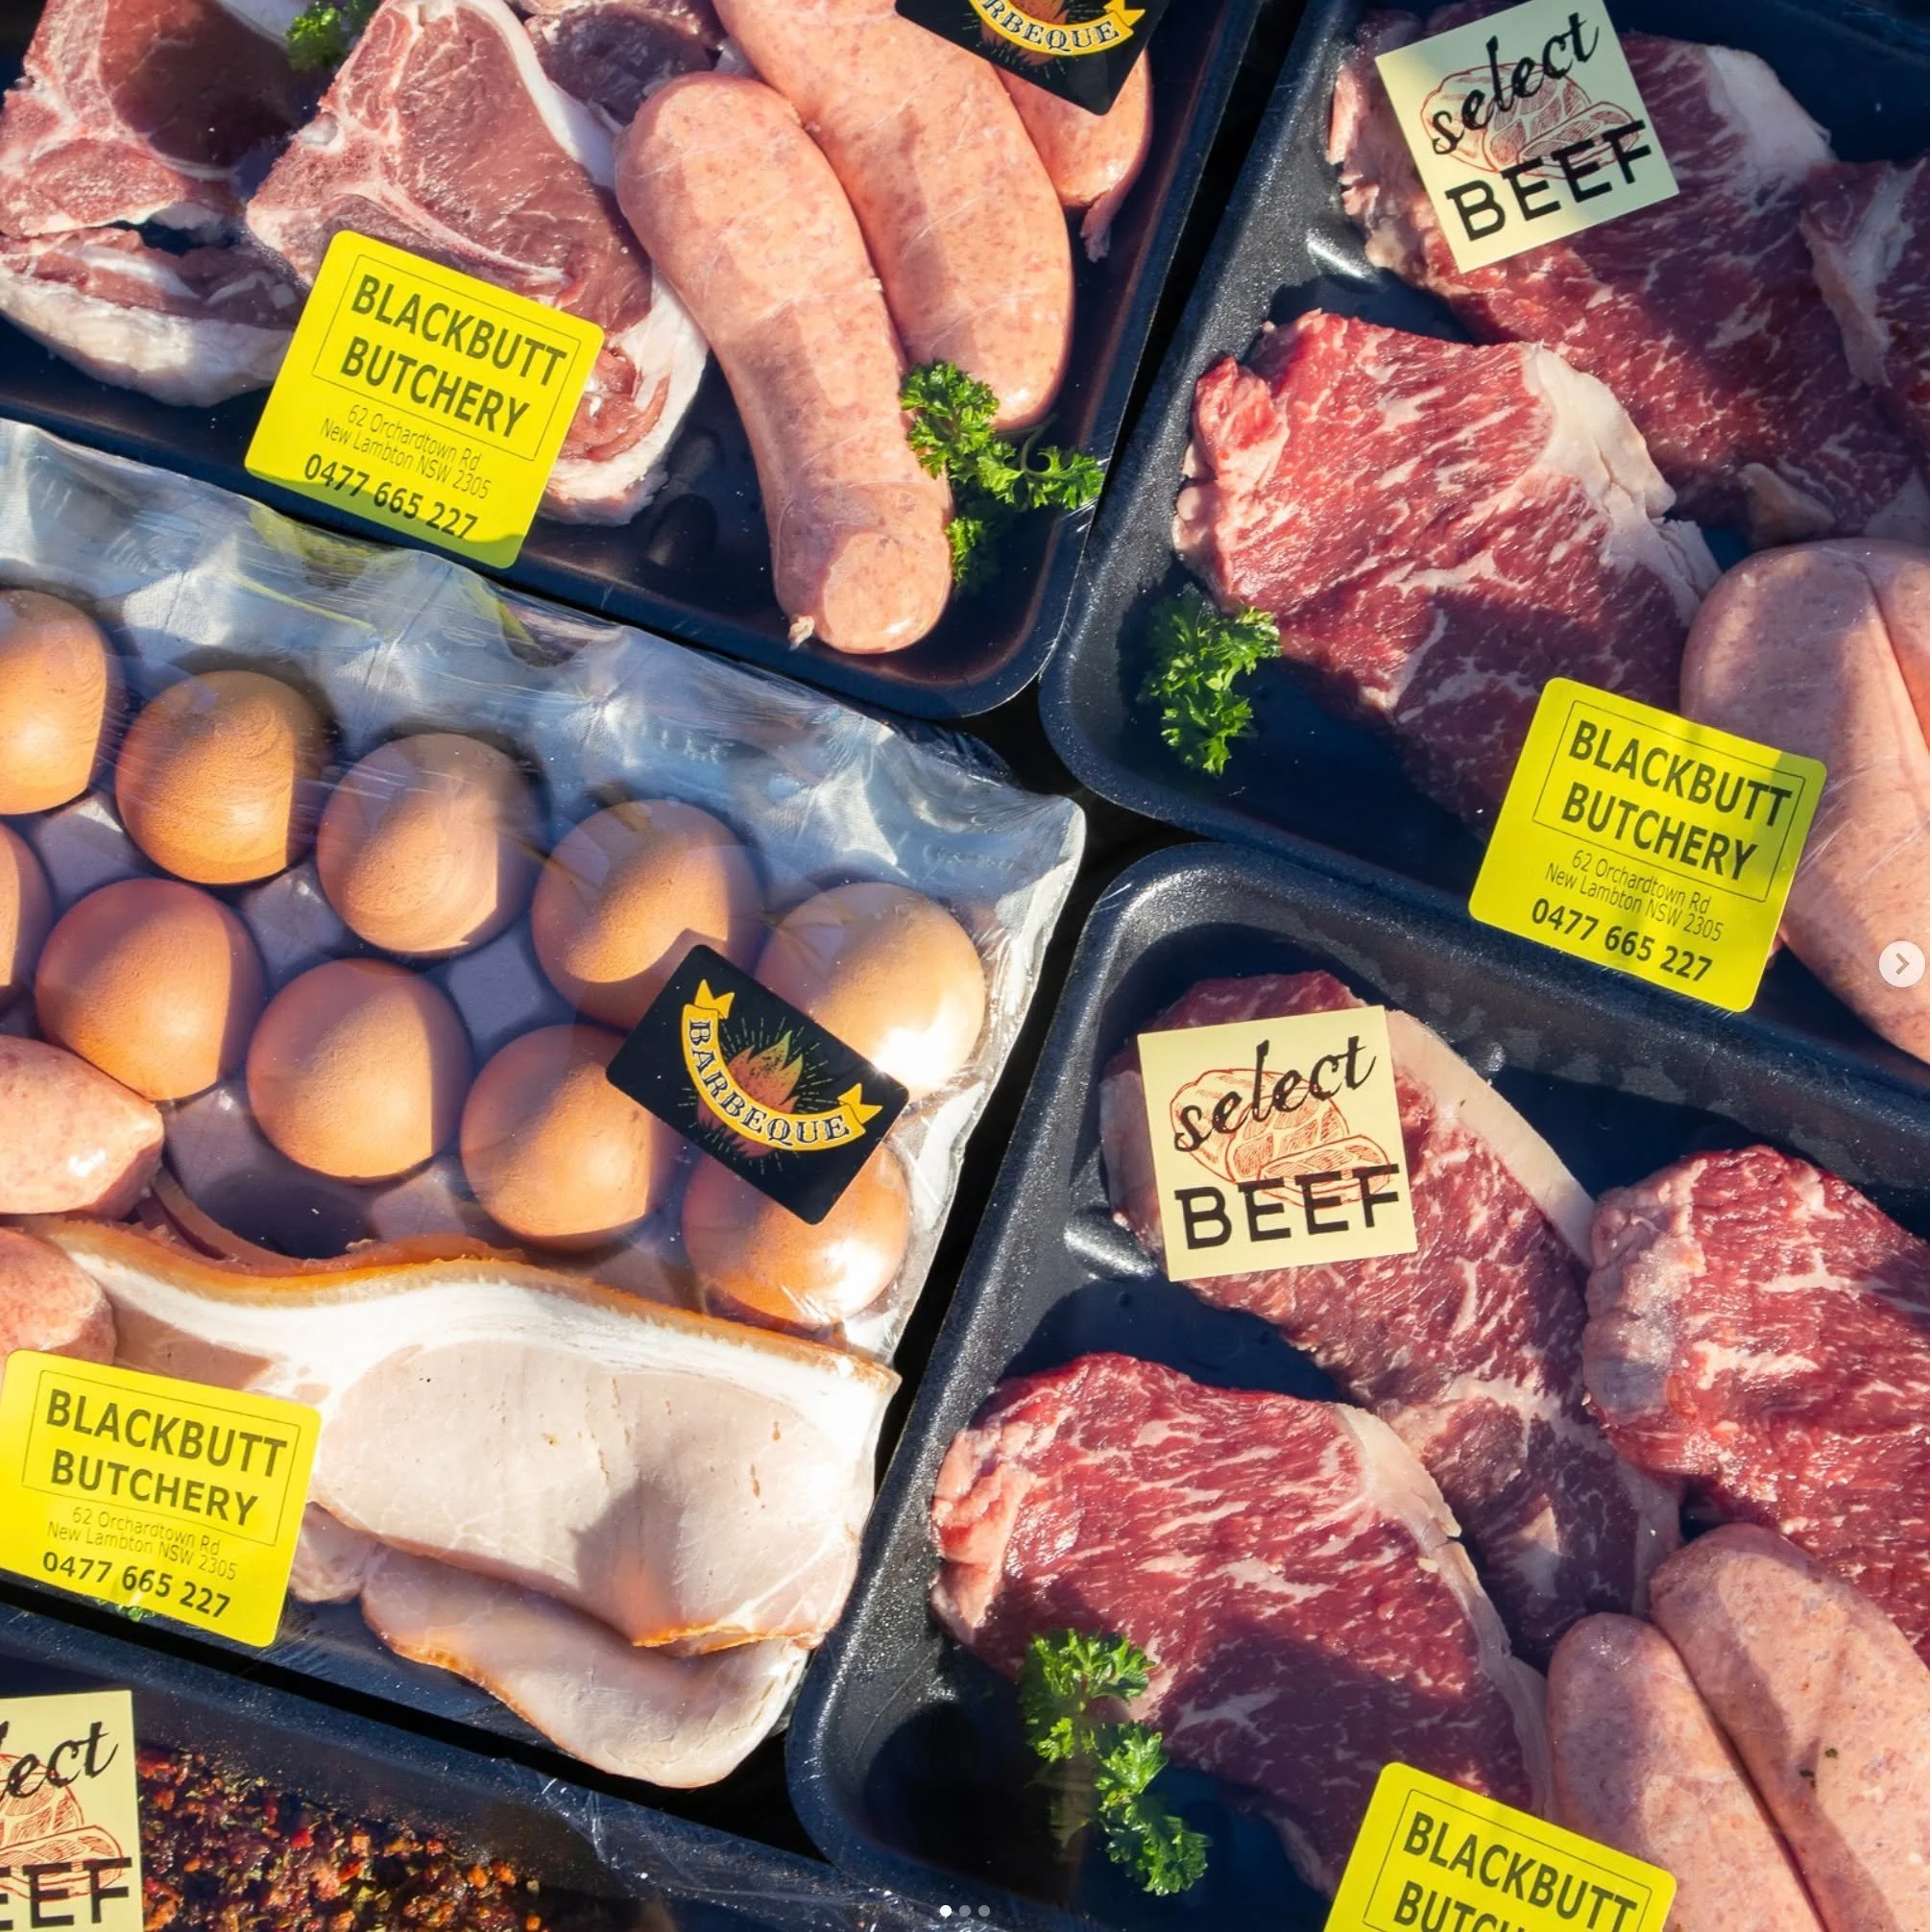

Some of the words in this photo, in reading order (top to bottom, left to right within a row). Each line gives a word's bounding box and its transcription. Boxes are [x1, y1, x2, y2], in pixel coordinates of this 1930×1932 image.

[981, 0, 1121, 52] RBEQUE
[1431, 12, 1600, 156] select
[1444, 119, 1653, 242] BEEF
[350, 274, 567, 386] BLACKBUTT
[340, 335, 530, 439] BUTCHERY
[319, 417, 351, 446] New
[352, 430, 414, 470] Lambton
[417, 455, 453, 485] NSW
[453, 469, 492, 499] 2305
[347, 403, 369, 427] 62
[370, 412, 457, 461] Orchardtown
[459, 446, 482, 471] Rd
[303, 453, 370, 497] 0477
[374, 481, 423, 520] 665
[425, 501, 479, 540] 227
[1568, 719, 1793, 828] BLACKBUTT
[1560, 781, 1759, 881] BUTCHERY
[1544, 862, 1579, 889] New
[1580, 875, 1642, 914] Lambton
[1645, 899, 1681, 928] NSW
[1682, 911, 1725, 943] 2305
[1572, 849, 1593, 872] 62
[1595, 855, 1686, 909] Orchardtown
[1688, 891, 1711, 914] Rd
[1532, 897, 1599, 942] 0477
[1604, 926, 1655, 962] 665
[1659, 944, 1713, 982] 227
[688, 1019, 850, 1147] BARBEQUE
[1173, 1035, 1377, 1152] select
[1173, 1163, 1400, 1250] BEEF
[45, 1388, 288, 1478] BLACKBUTT
[50, 1448, 259, 1527] BUTCHERY
[47, 1520, 80, 1541] New
[85, 1528, 154, 1555] Lambton
[158, 1541, 194, 1566] NSW
[199, 1554, 239, 1582] 2305
[72, 1506, 93, 1525] 62
[97, 1510, 196, 1549] Orchardtown
[201, 1534, 221, 1557] Rd
[42, 1551, 113, 1583] 0477
[122, 1564, 173, 1598] 665
[179, 1581, 231, 1619] 227
[0, 1856, 133, 1932] EF
[1403, 1810, 1638, 1932] BLACKBUTT
